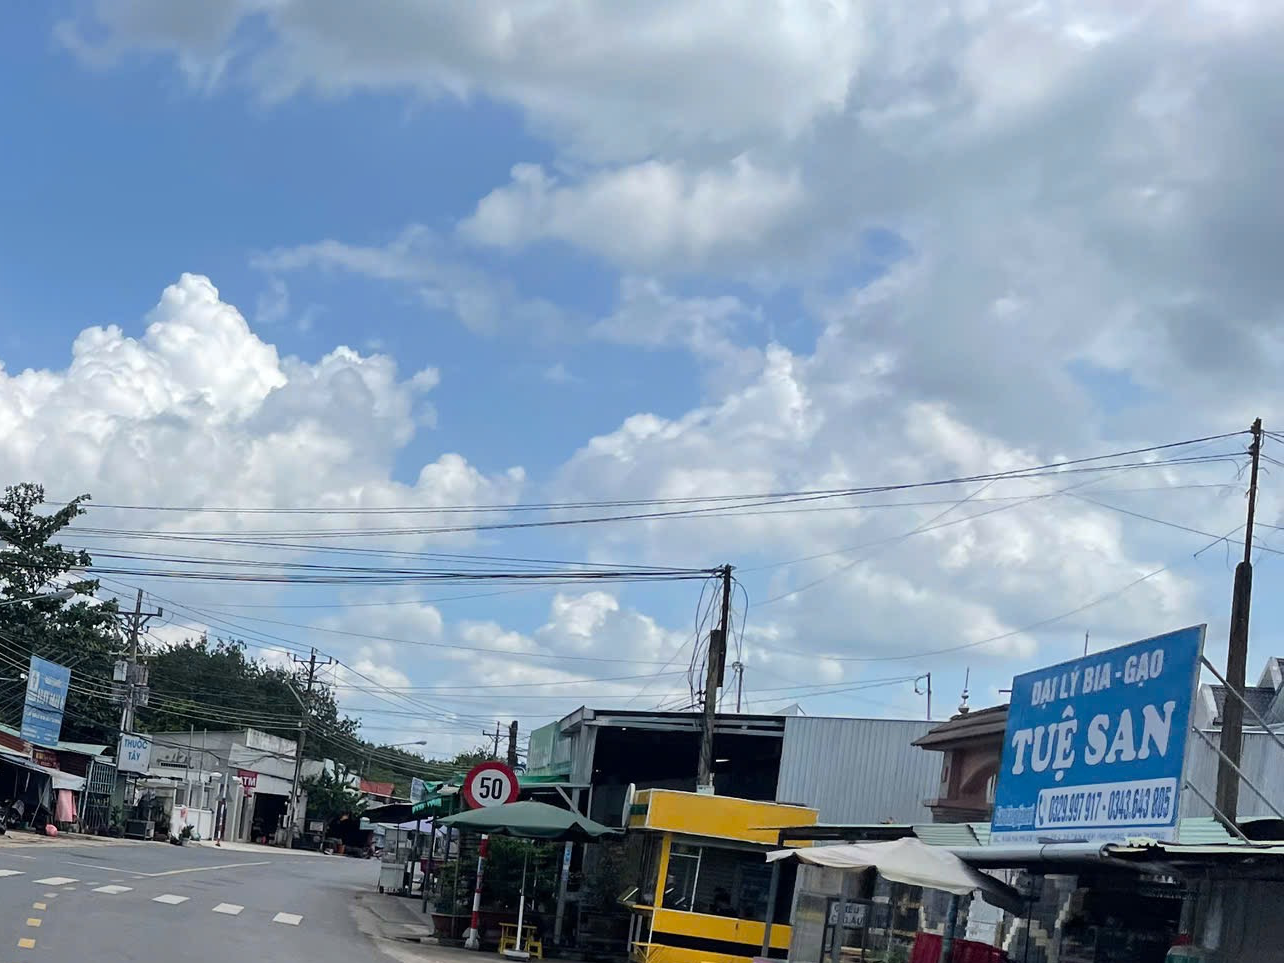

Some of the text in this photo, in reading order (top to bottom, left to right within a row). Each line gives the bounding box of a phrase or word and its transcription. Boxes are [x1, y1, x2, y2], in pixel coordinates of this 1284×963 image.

[1031, 676, 1056, 709] ĐẠI
[1059, 664, 1080, 699] LÝ
[1082, 662, 1111, 694] BIA
[1123, 649, 1164, 687] GẠO
[1011, 700, 1176, 782] TUỆ SAN
[479, 776, 503, 800] 50
[1085, 791, 1102, 822] 917
